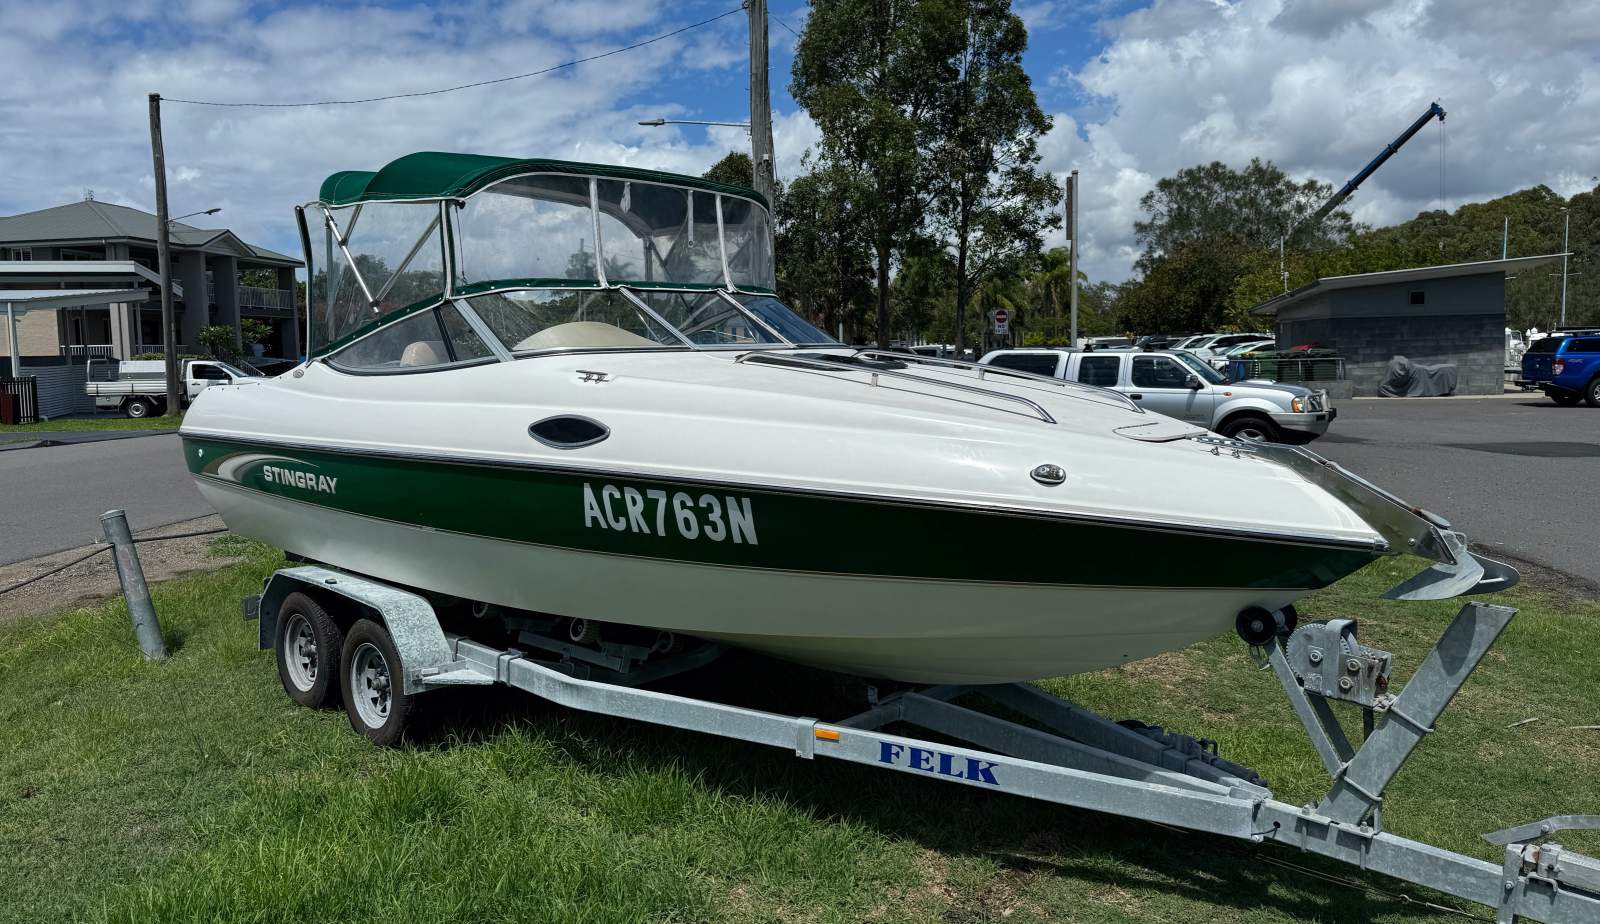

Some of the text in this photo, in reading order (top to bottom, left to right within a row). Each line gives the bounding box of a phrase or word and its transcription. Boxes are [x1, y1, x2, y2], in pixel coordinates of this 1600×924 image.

[263, 465, 337, 494] STINGRAY
[583, 483, 758, 545] ACR763N
[878, 741, 1000, 785] FELK
